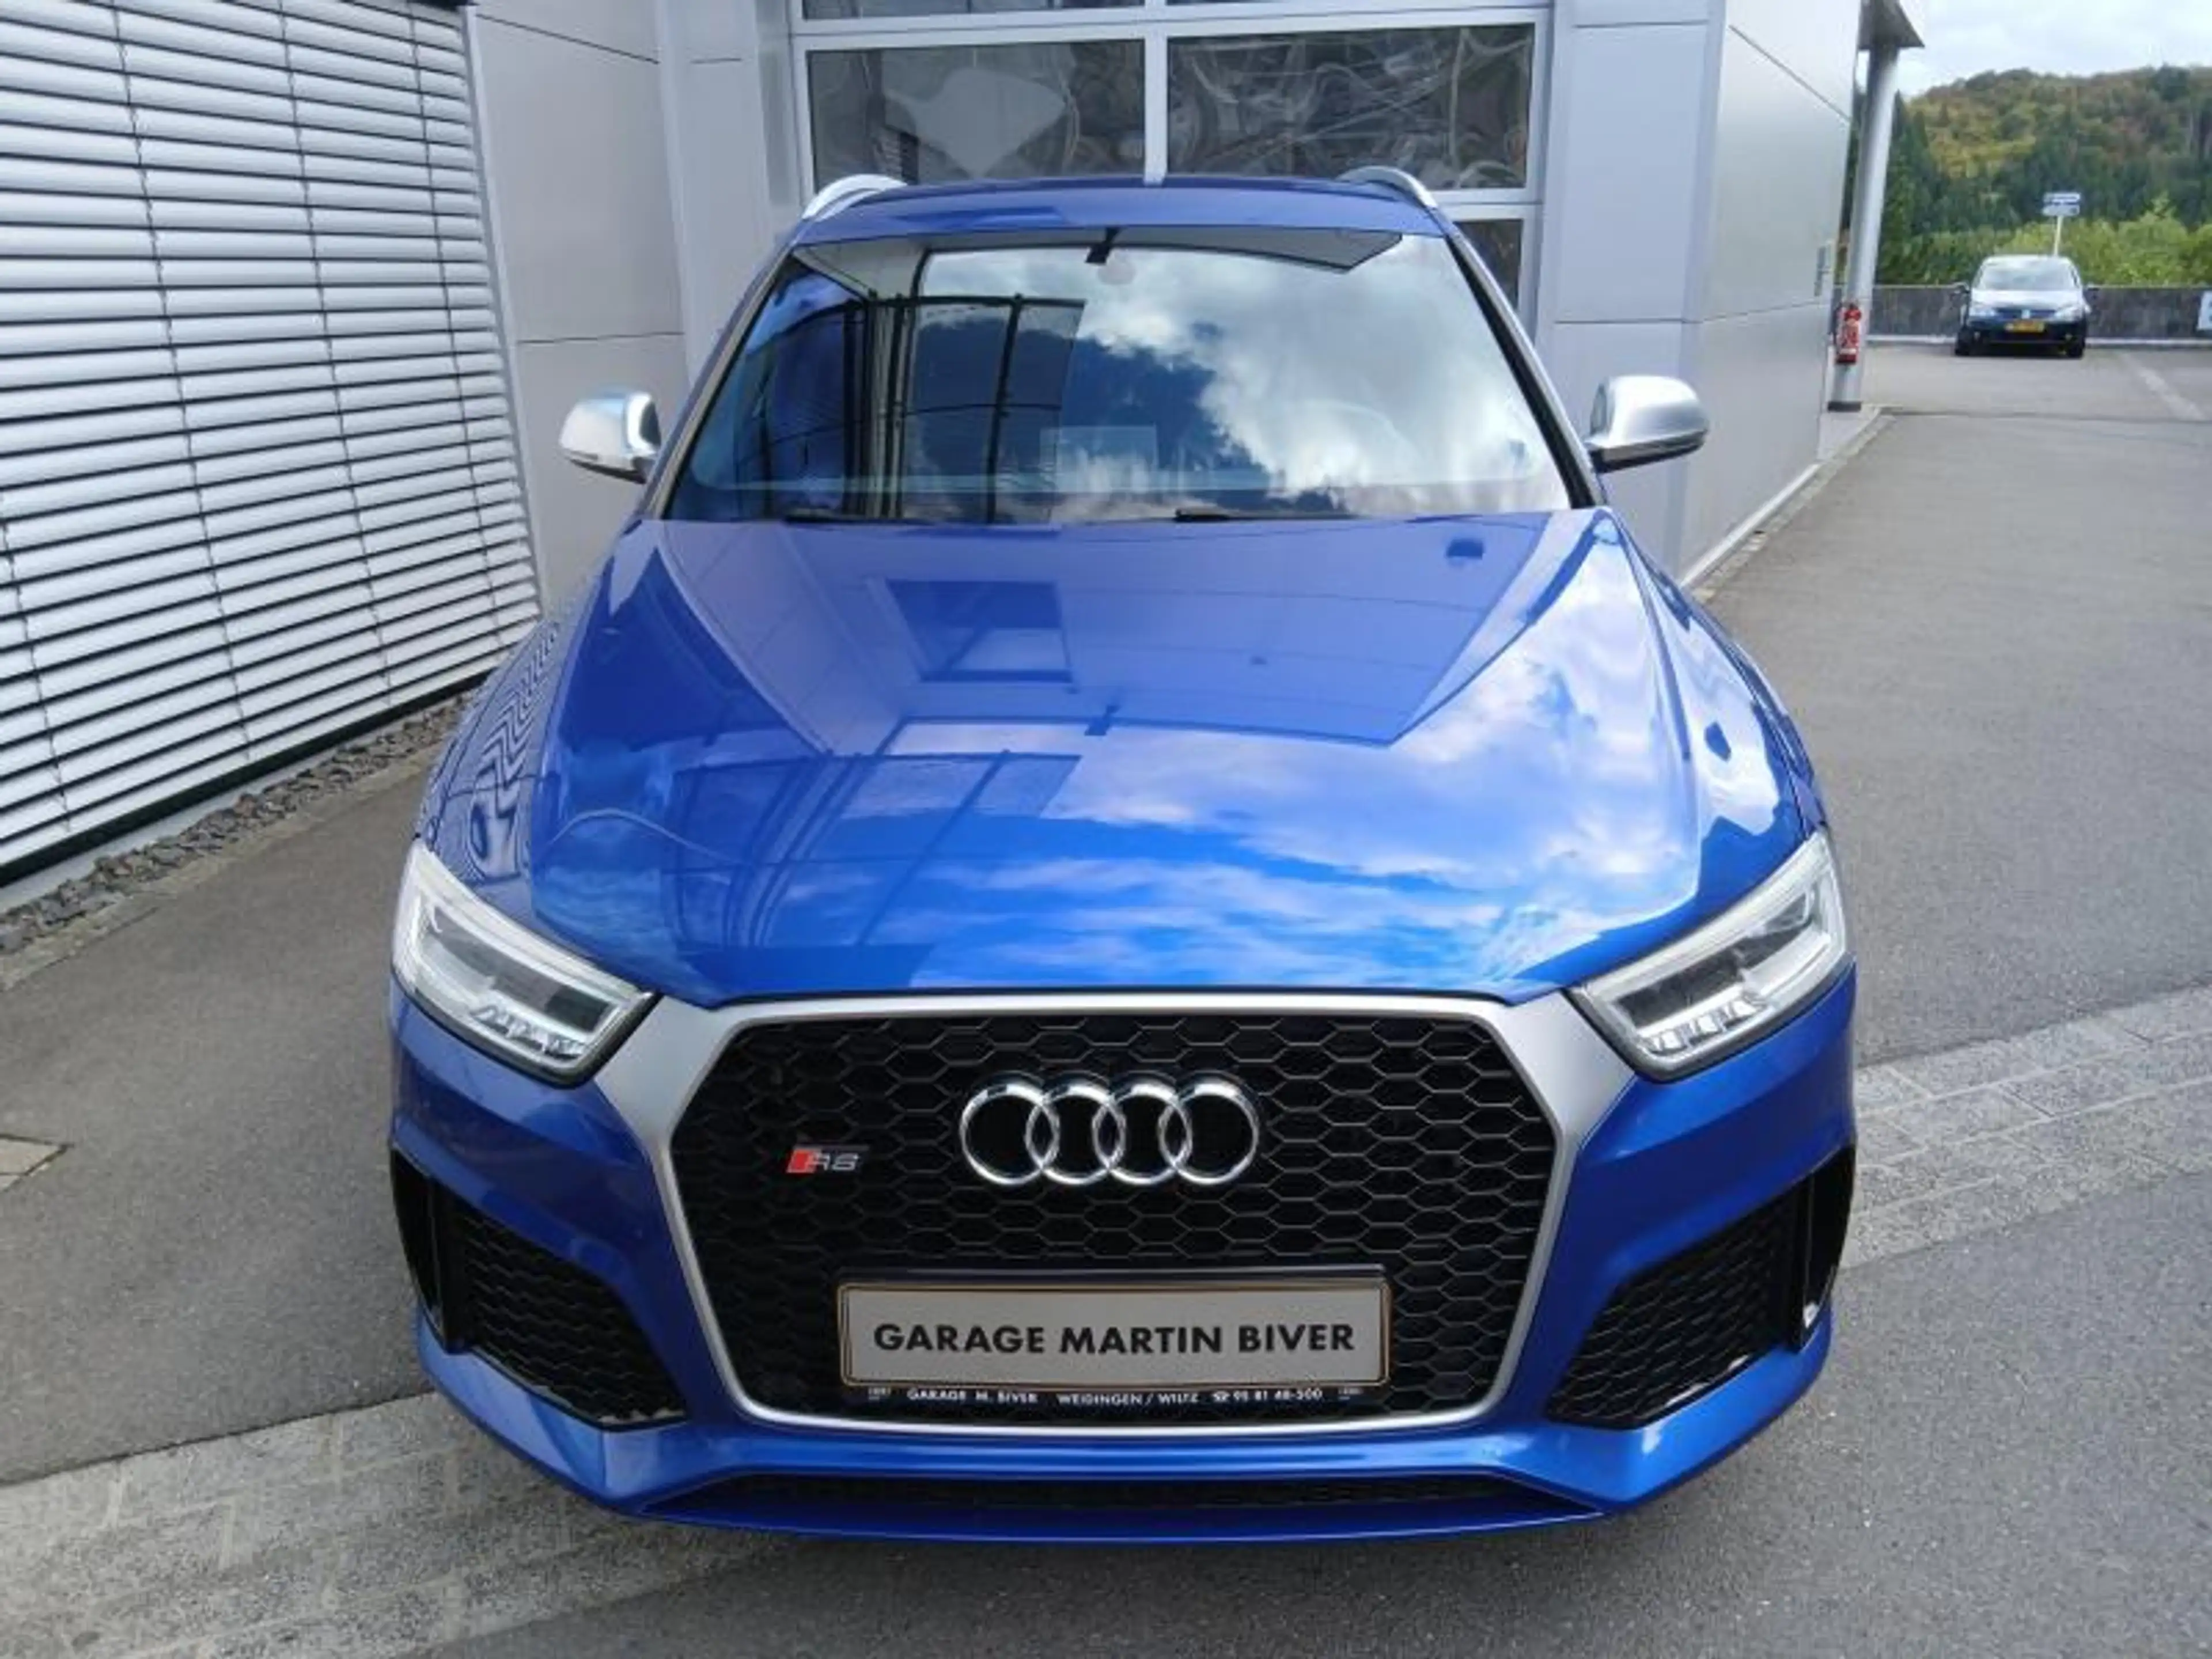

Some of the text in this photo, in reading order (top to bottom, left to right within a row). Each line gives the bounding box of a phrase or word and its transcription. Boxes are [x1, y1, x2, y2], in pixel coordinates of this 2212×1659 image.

[873, 1323, 1355, 1354] GARAGE MARTIN BIVER
